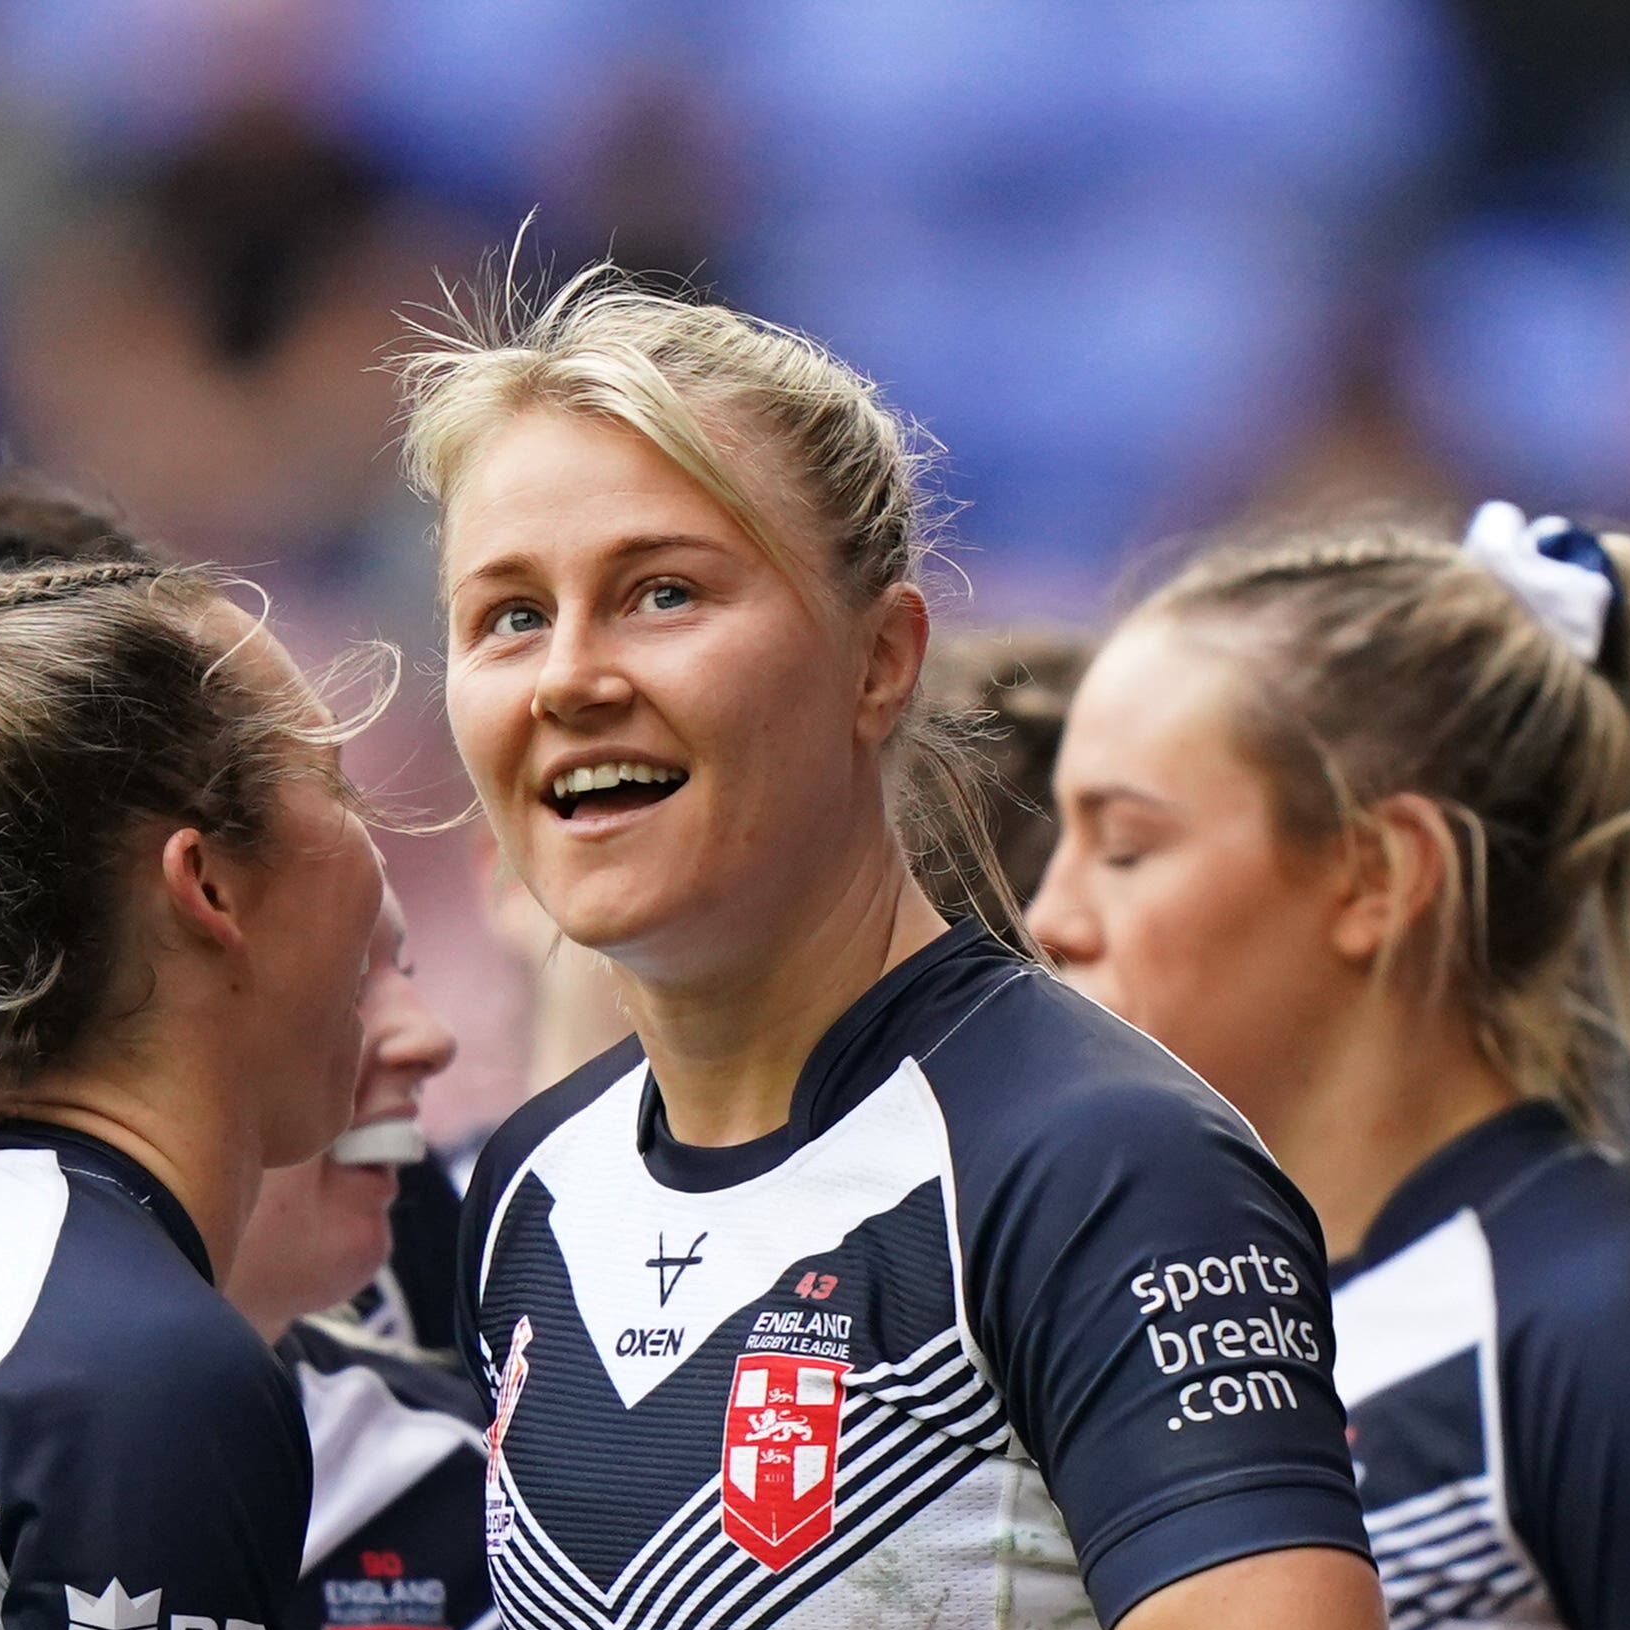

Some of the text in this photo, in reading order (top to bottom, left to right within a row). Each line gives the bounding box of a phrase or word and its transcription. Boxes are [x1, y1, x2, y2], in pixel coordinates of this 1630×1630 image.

[794, 1272, 838, 1300] 43
[1131, 1244, 1299, 1314] sports
[752, 1312, 852, 1339] ENGLAND
[1146, 1306, 1319, 1374] breaks
[615, 1327, 685, 1357] OXEN
[745, 1334, 850, 1360] RUGBY LEAGUE
[1167, 1370, 1298, 1431] .com
